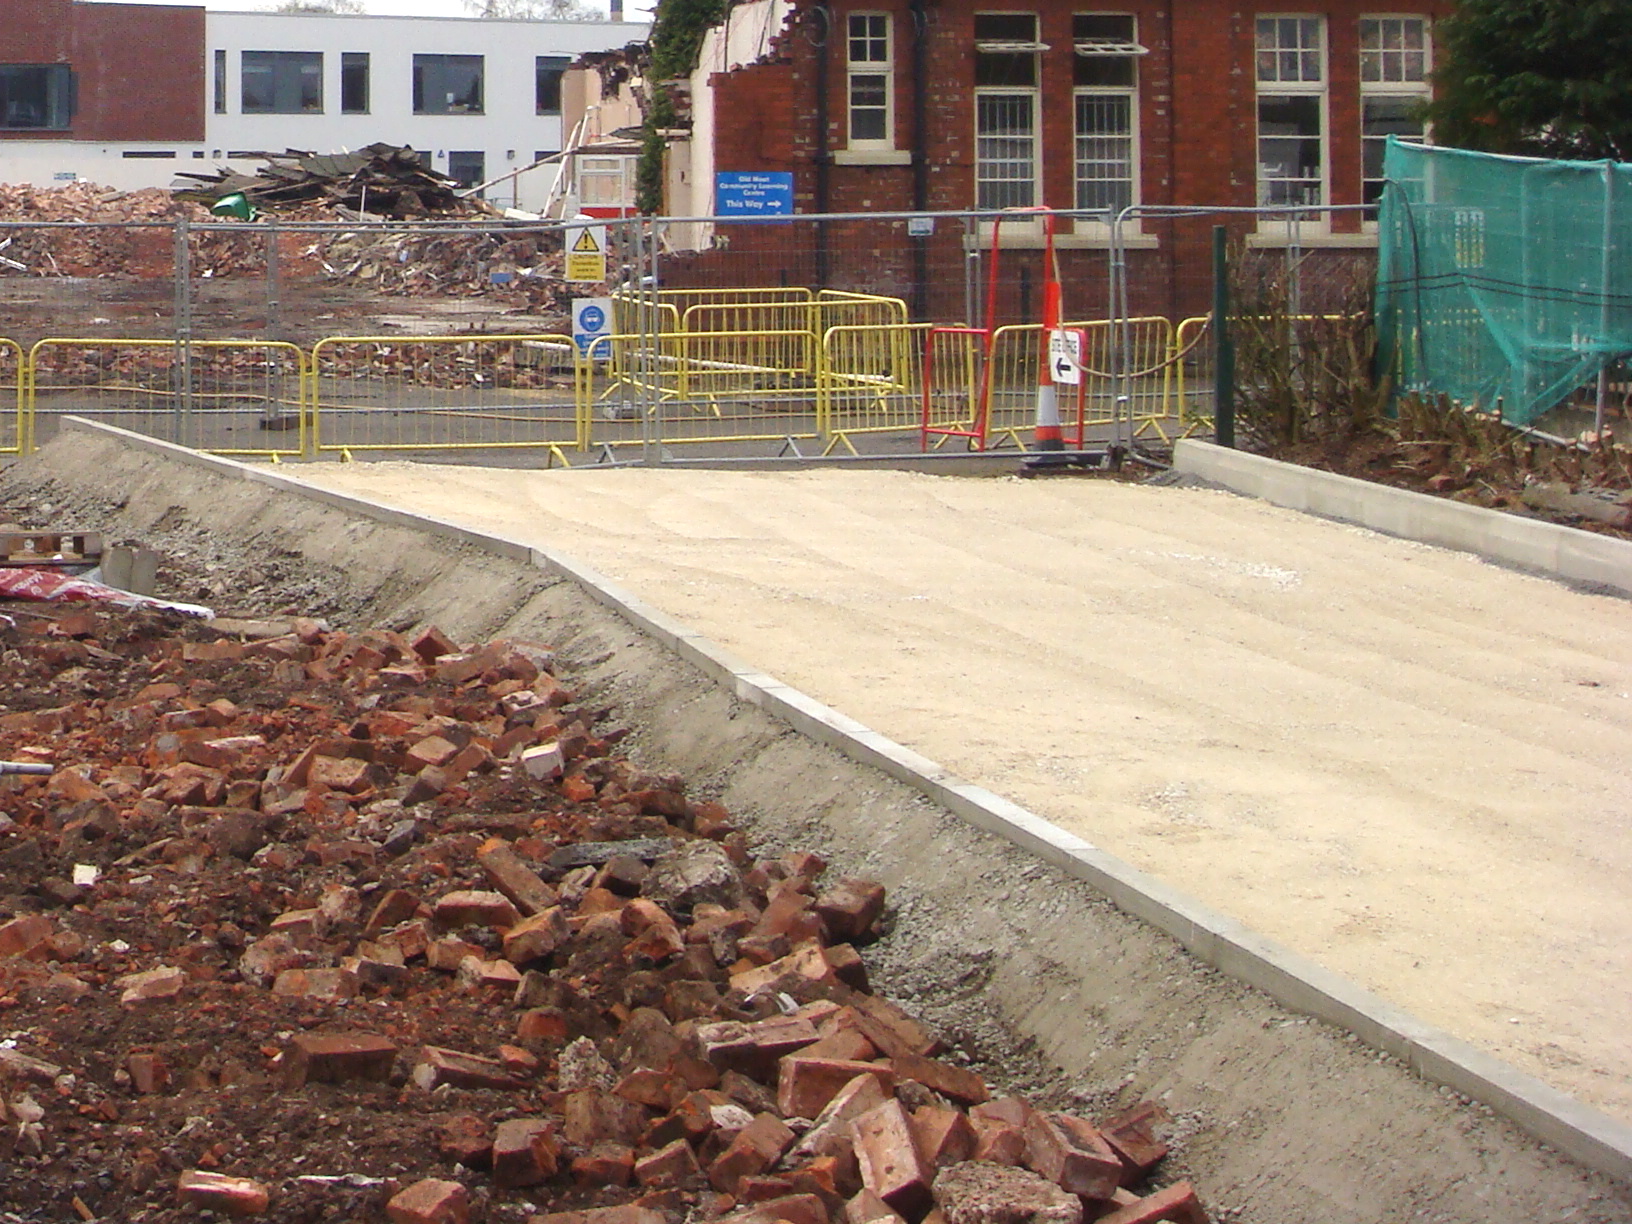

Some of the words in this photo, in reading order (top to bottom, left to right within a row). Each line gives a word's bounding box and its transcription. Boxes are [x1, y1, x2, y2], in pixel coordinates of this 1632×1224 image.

[719, 182, 757, 191] Community
[725, 199, 744, 208] This
[744, 200, 764, 210] Way
